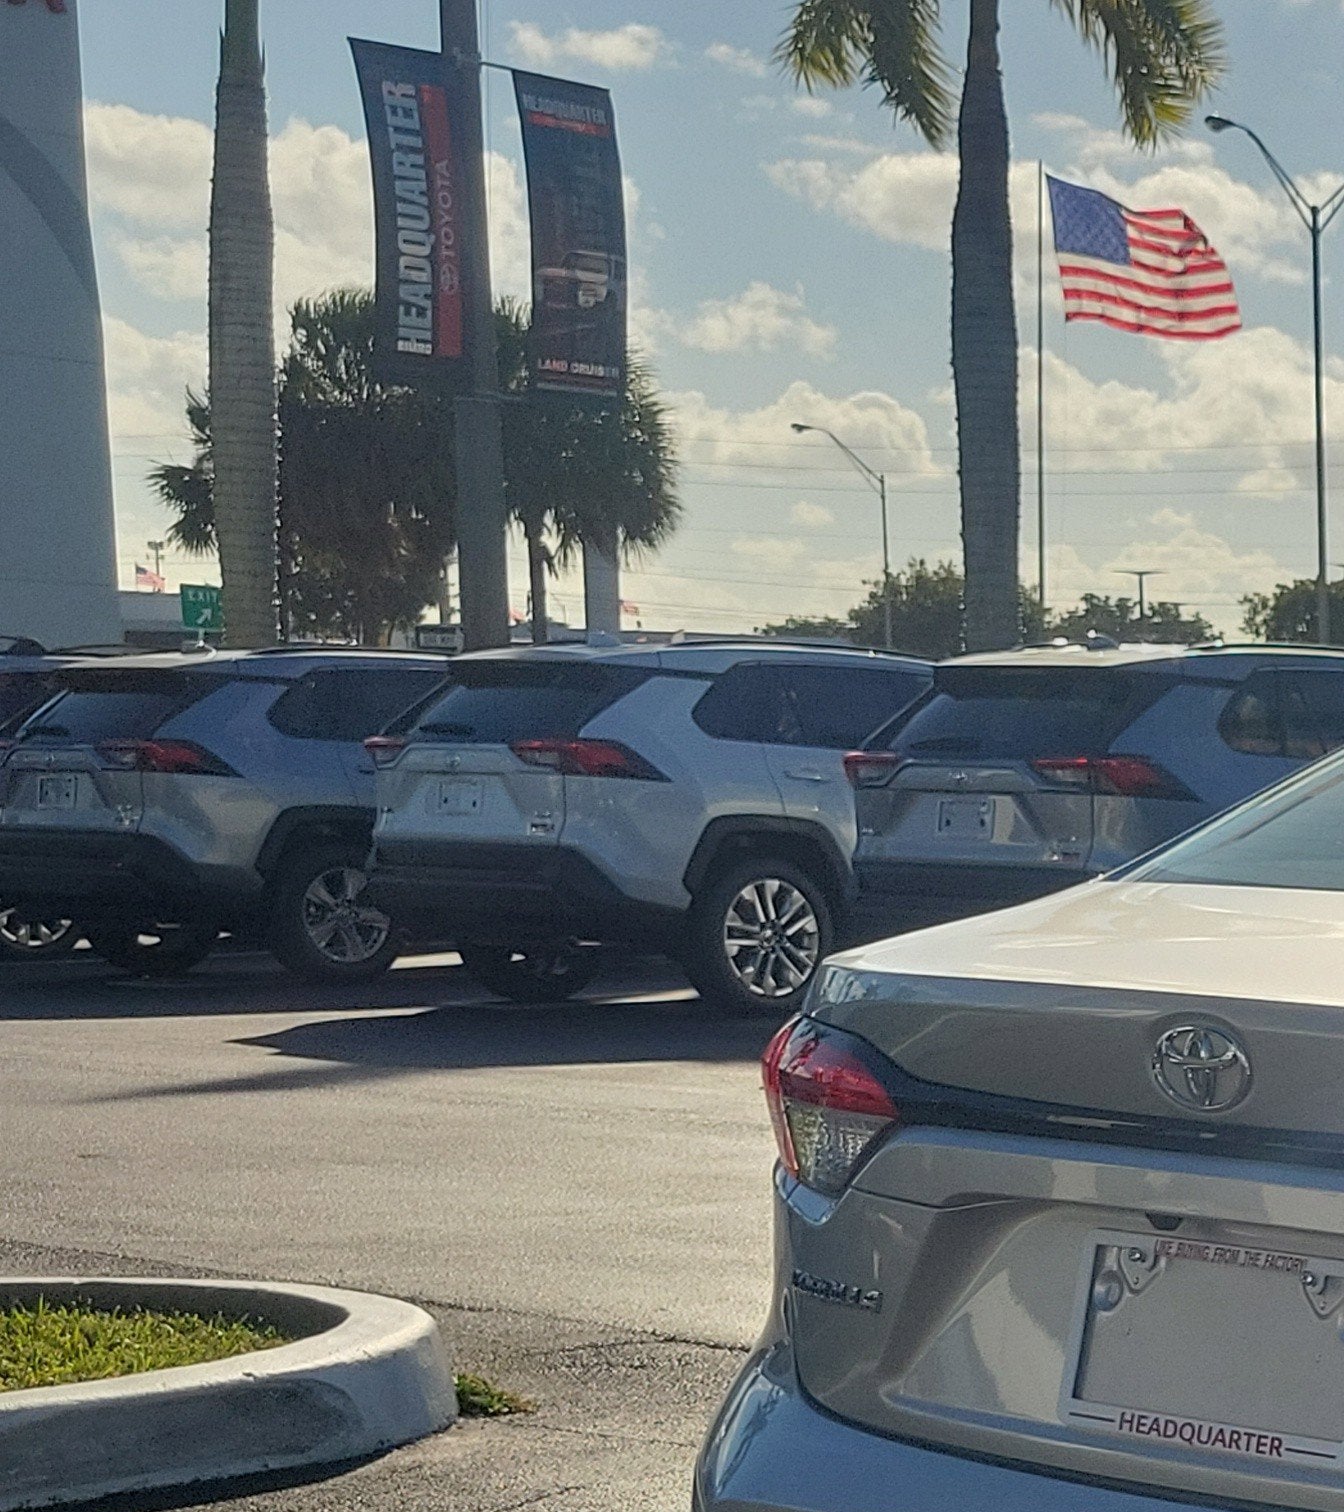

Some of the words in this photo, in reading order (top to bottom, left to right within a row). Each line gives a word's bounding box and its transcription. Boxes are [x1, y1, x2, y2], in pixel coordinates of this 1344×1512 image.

[382, 80, 435, 356] HEADQUARTER
[436, 158, 455, 263] TOYOTA
[188, 589, 217, 603] EXIT
[1118, 1411, 1283, 1458] HEADQUARTER
